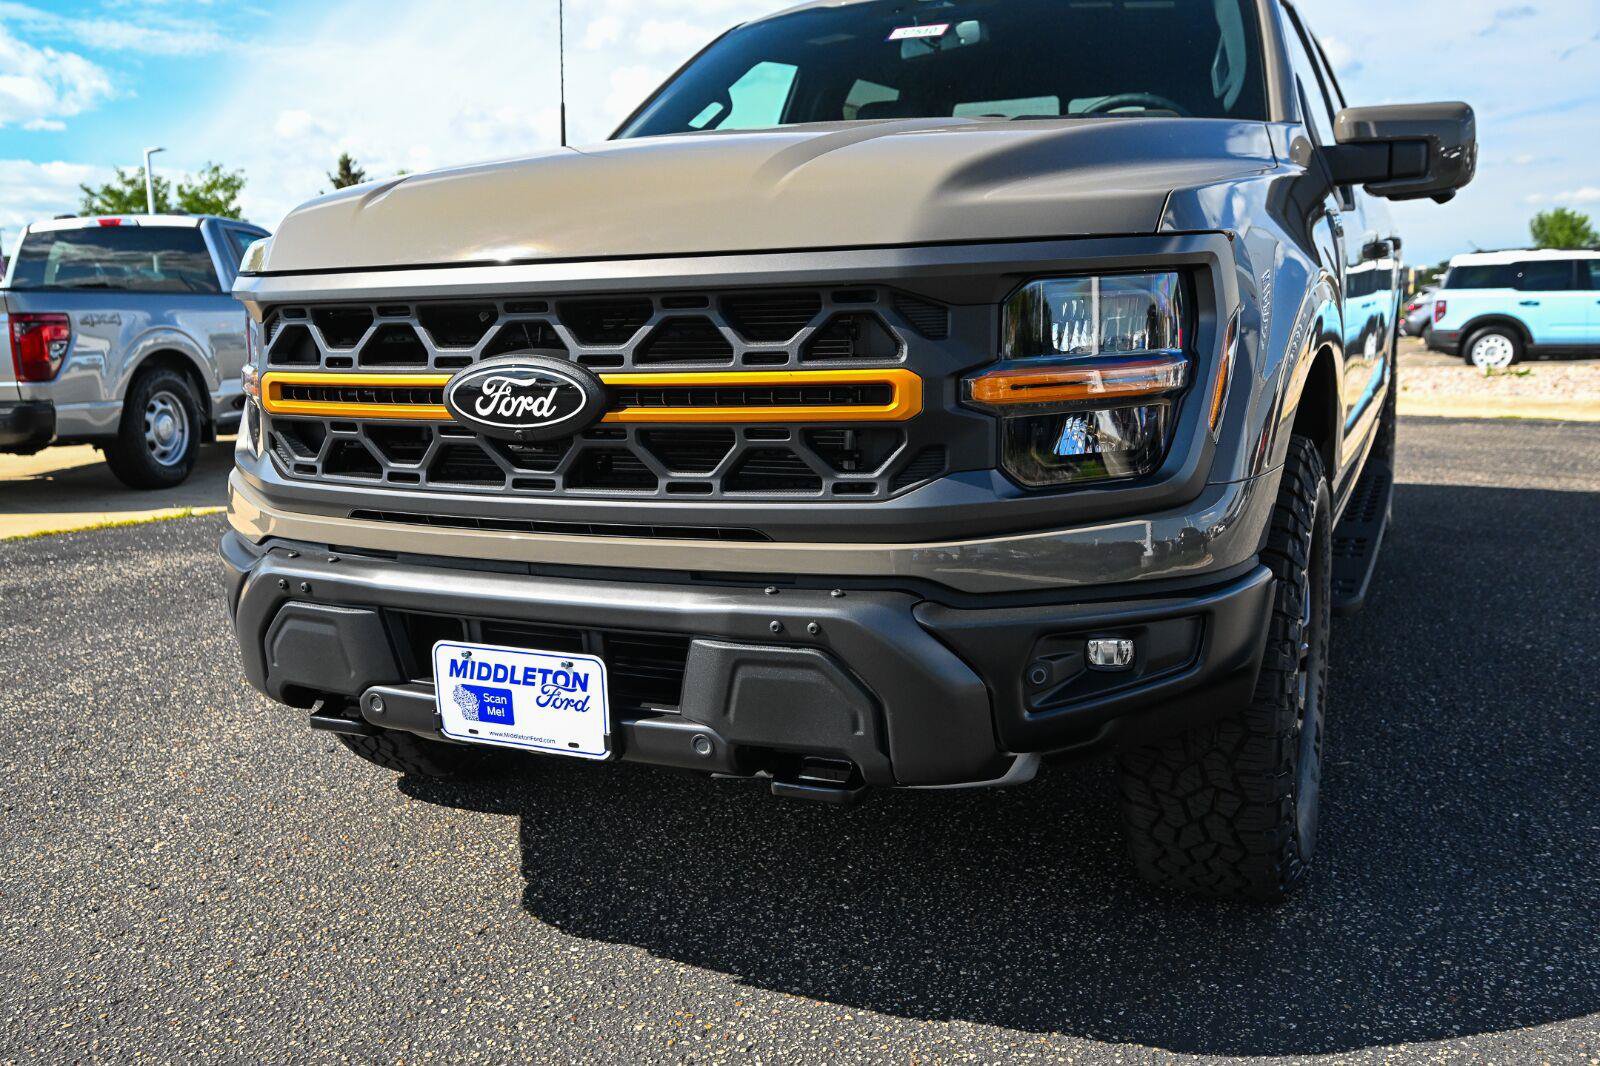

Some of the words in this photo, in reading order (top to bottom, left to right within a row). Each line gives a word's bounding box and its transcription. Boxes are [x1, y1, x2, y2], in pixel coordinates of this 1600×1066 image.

[475, 376, 557, 417] Ford
[449, 658, 590, 692] MIDDLETON
[483, 693, 508, 705] Scan
[535, 684, 591, 713] Ford
[487, 706, 506, 717] Me!
[488, 730, 556, 745] www.MiddletonFord.com
